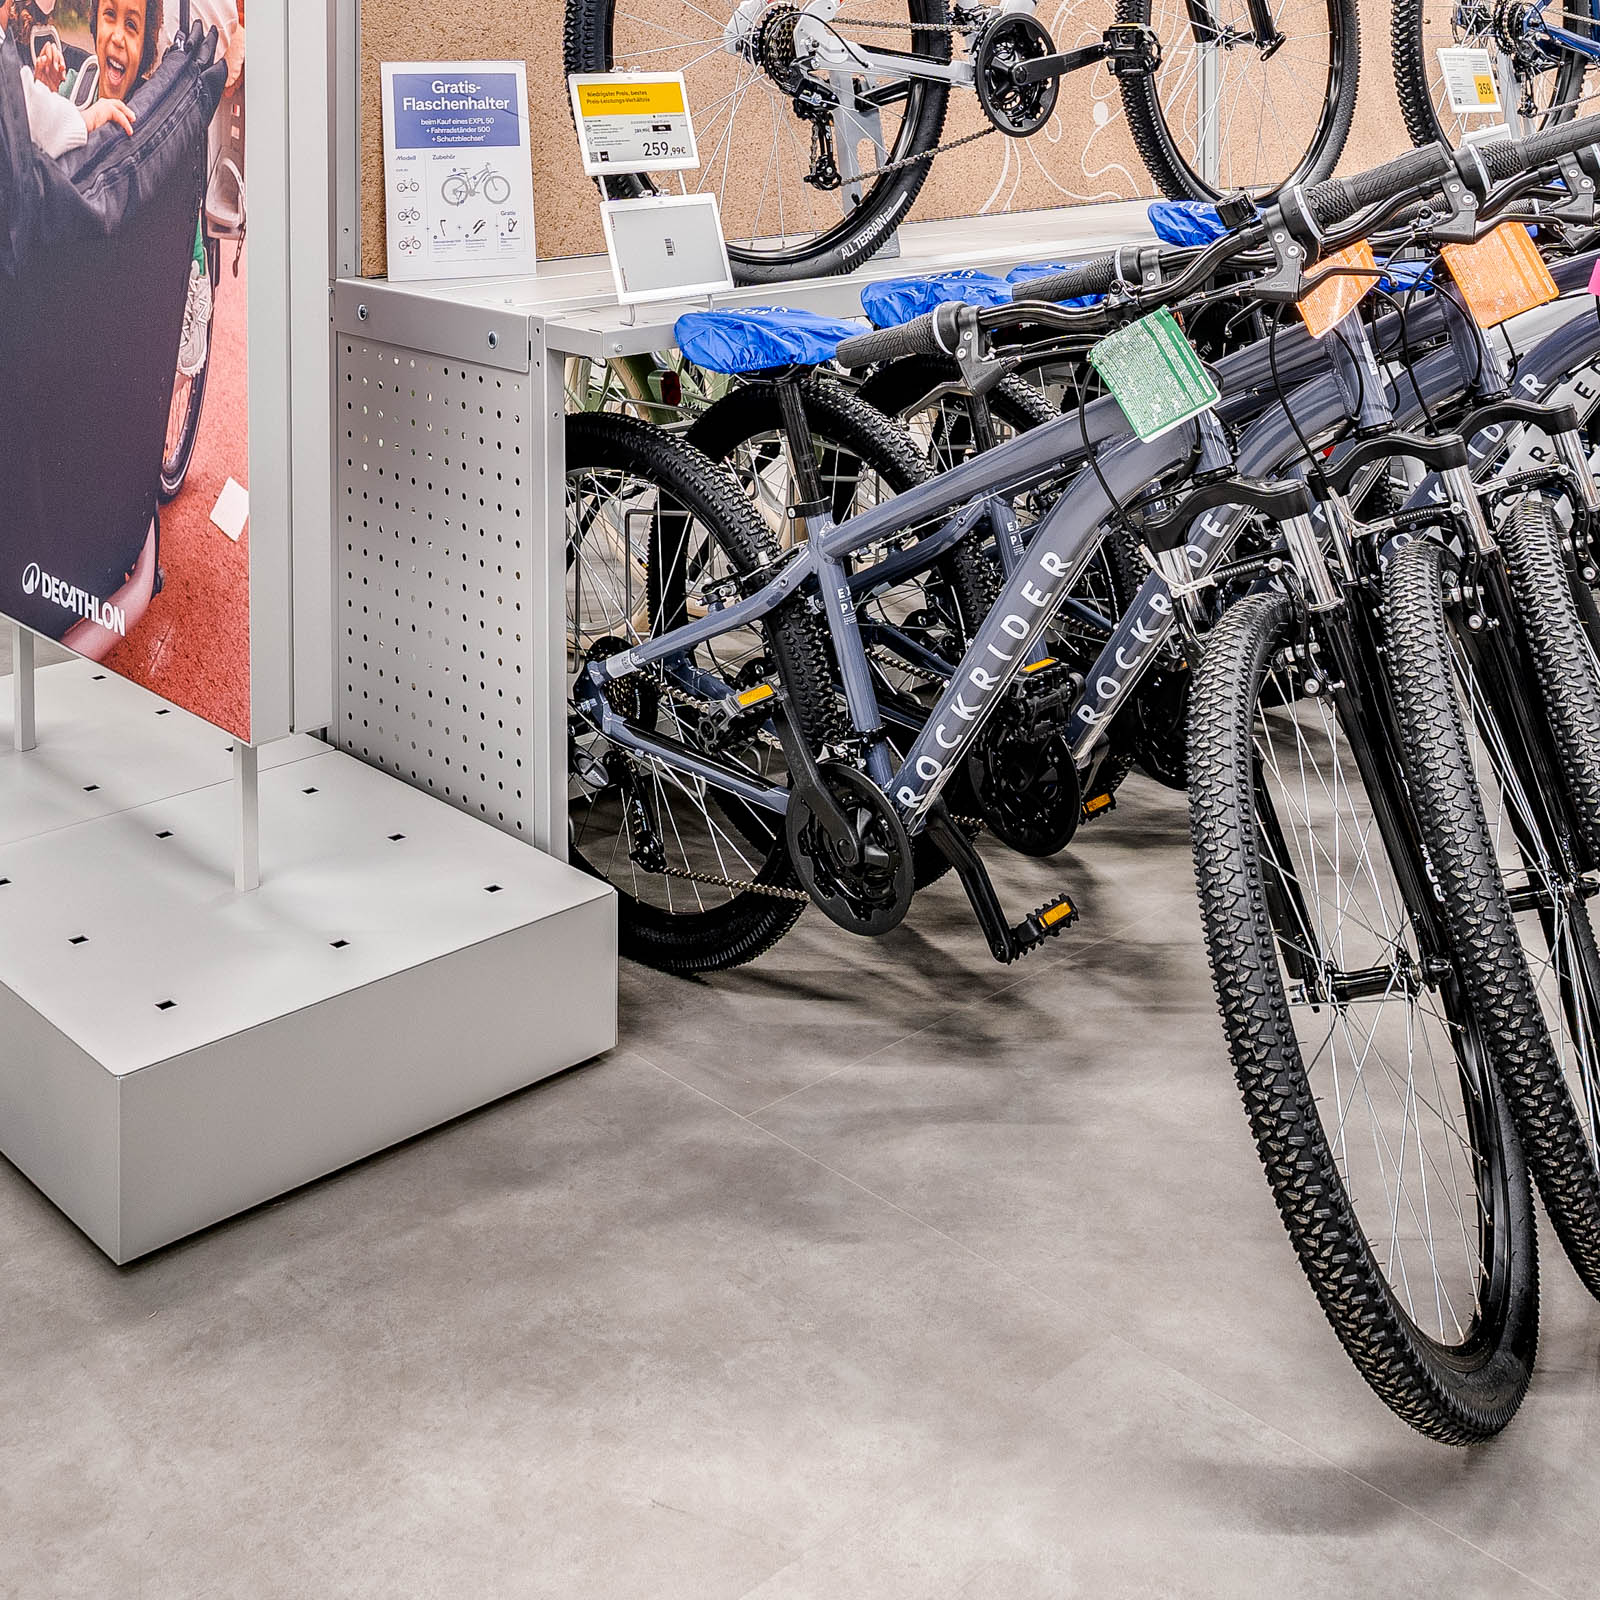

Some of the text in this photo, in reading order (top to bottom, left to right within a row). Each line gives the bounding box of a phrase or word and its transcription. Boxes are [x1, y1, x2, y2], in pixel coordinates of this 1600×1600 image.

[431, 80, 481, 94] Gratis-
[403, 96, 510, 111] Flaschenhalter
[436, 118, 451, 126] Kauf
[430, 126, 477, 134] Fahrradständer
[642, 141, 686, 157] 259,99€
[41, 570, 126, 637] DECATHLON
[897, 549, 1074, 809] ROCKRIDER
